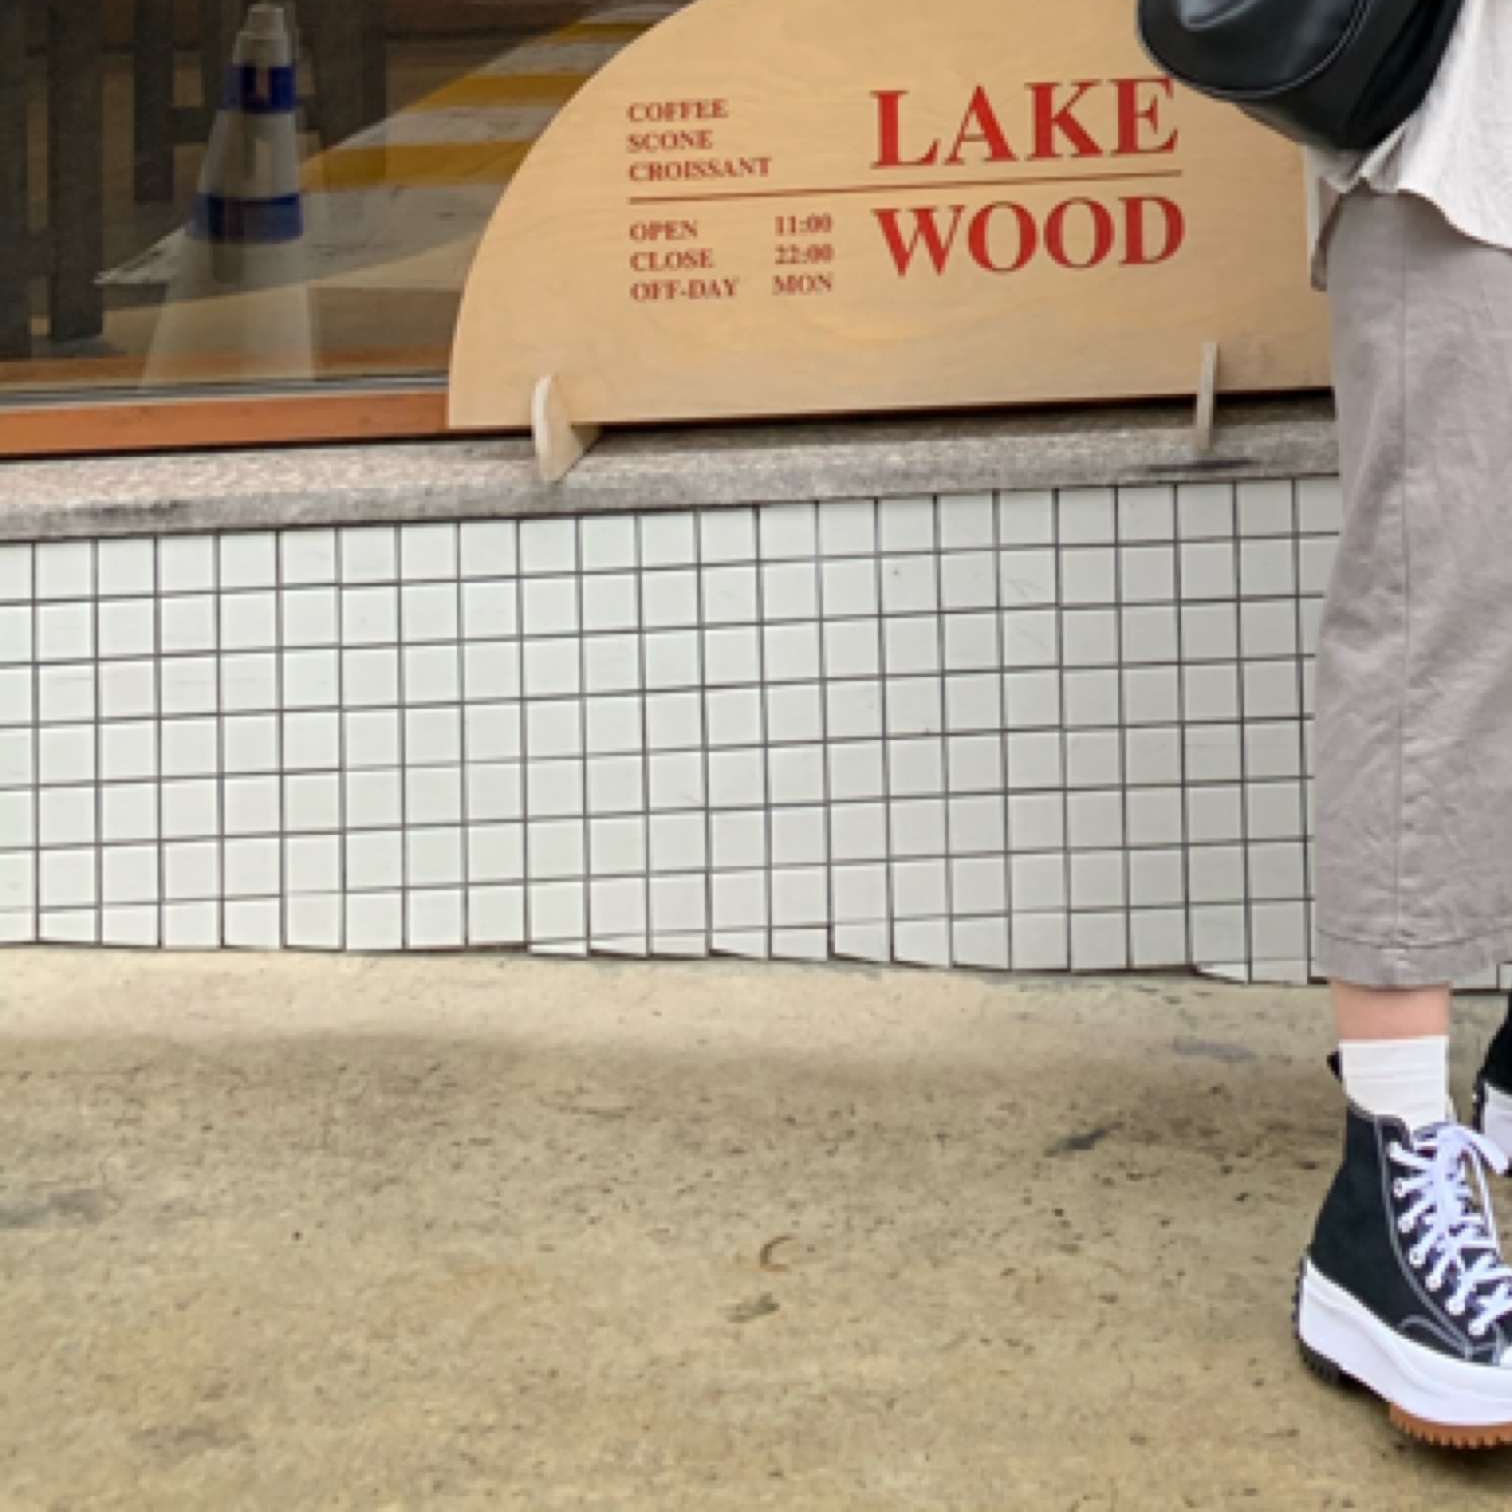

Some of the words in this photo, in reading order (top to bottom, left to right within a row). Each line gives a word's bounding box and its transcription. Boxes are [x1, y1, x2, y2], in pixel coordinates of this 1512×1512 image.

[627, 98, 729, 123] COFFEE
[870, 76, 1179, 170] LAKE
[626, 129, 713, 154] SCONE
[627, 156, 772, 182] CROISSANT
[629, 219, 698, 243] OPEN
[775, 212, 833, 236] 11:00
[871, 195, 1185, 278] WOOD
[629, 247, 715, 272] CLOSE
[775, 243, 835, 265] 22:00
[629, 275, 740, 302] OFF-DAY
[772, 272, 834, 296] MON
